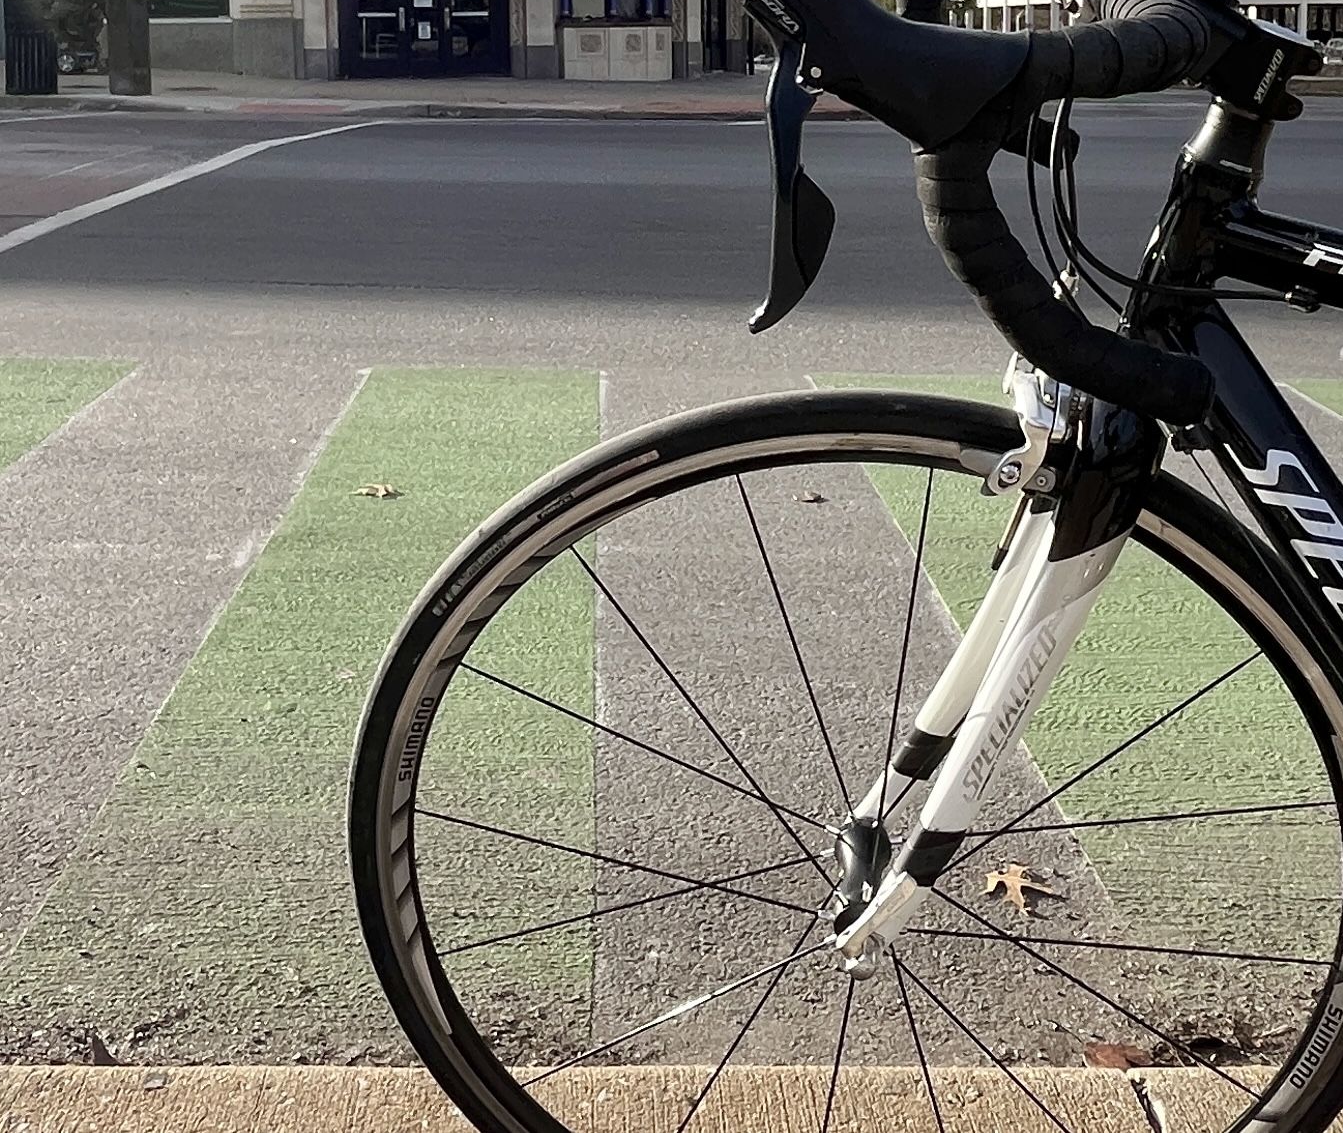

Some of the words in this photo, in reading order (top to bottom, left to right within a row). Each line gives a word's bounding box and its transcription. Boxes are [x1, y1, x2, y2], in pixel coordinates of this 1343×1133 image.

[398, 697, 435, 782] SHIMANO
[962, 623, 1057, 804] SPECIALIZED
[1289, 1003, 1343, 1090] SHIMANO
